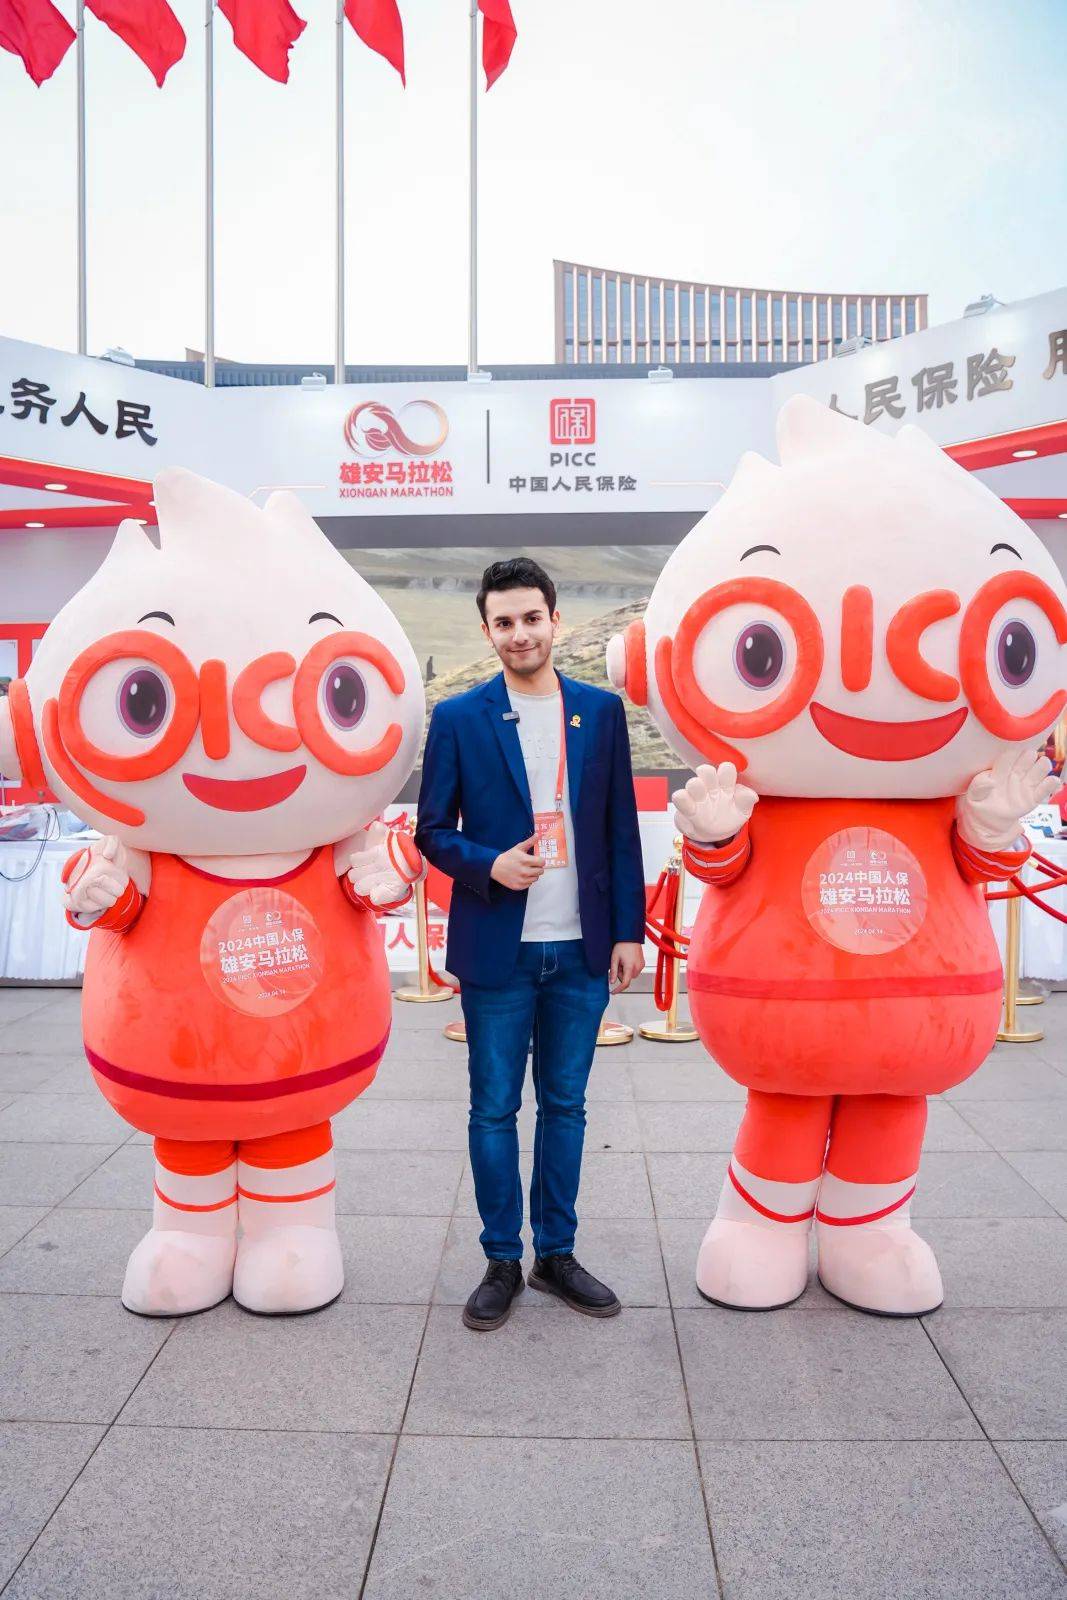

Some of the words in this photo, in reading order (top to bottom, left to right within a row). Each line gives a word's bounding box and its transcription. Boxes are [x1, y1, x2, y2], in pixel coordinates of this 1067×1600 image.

[0, 377, 158, 446] 务人民
[550, 452, 596, 467] PICC
[339, 460, 453, 484] 雄安马拉松
[339, 487, 388, 498] XIONGAN
[390, 486, 454, 497] MARATHON
[509, 476, 637, 493] 中国人民保险
[820, 871, 908, 885] 2024中国人保
[820, 887, 911, 905] 雄安马拉松
[218, 928, 304, 952] 2024中国人保
[377, 922, 445, 951] 人保
[220, 944, 309, 975] 雄安马拉松
